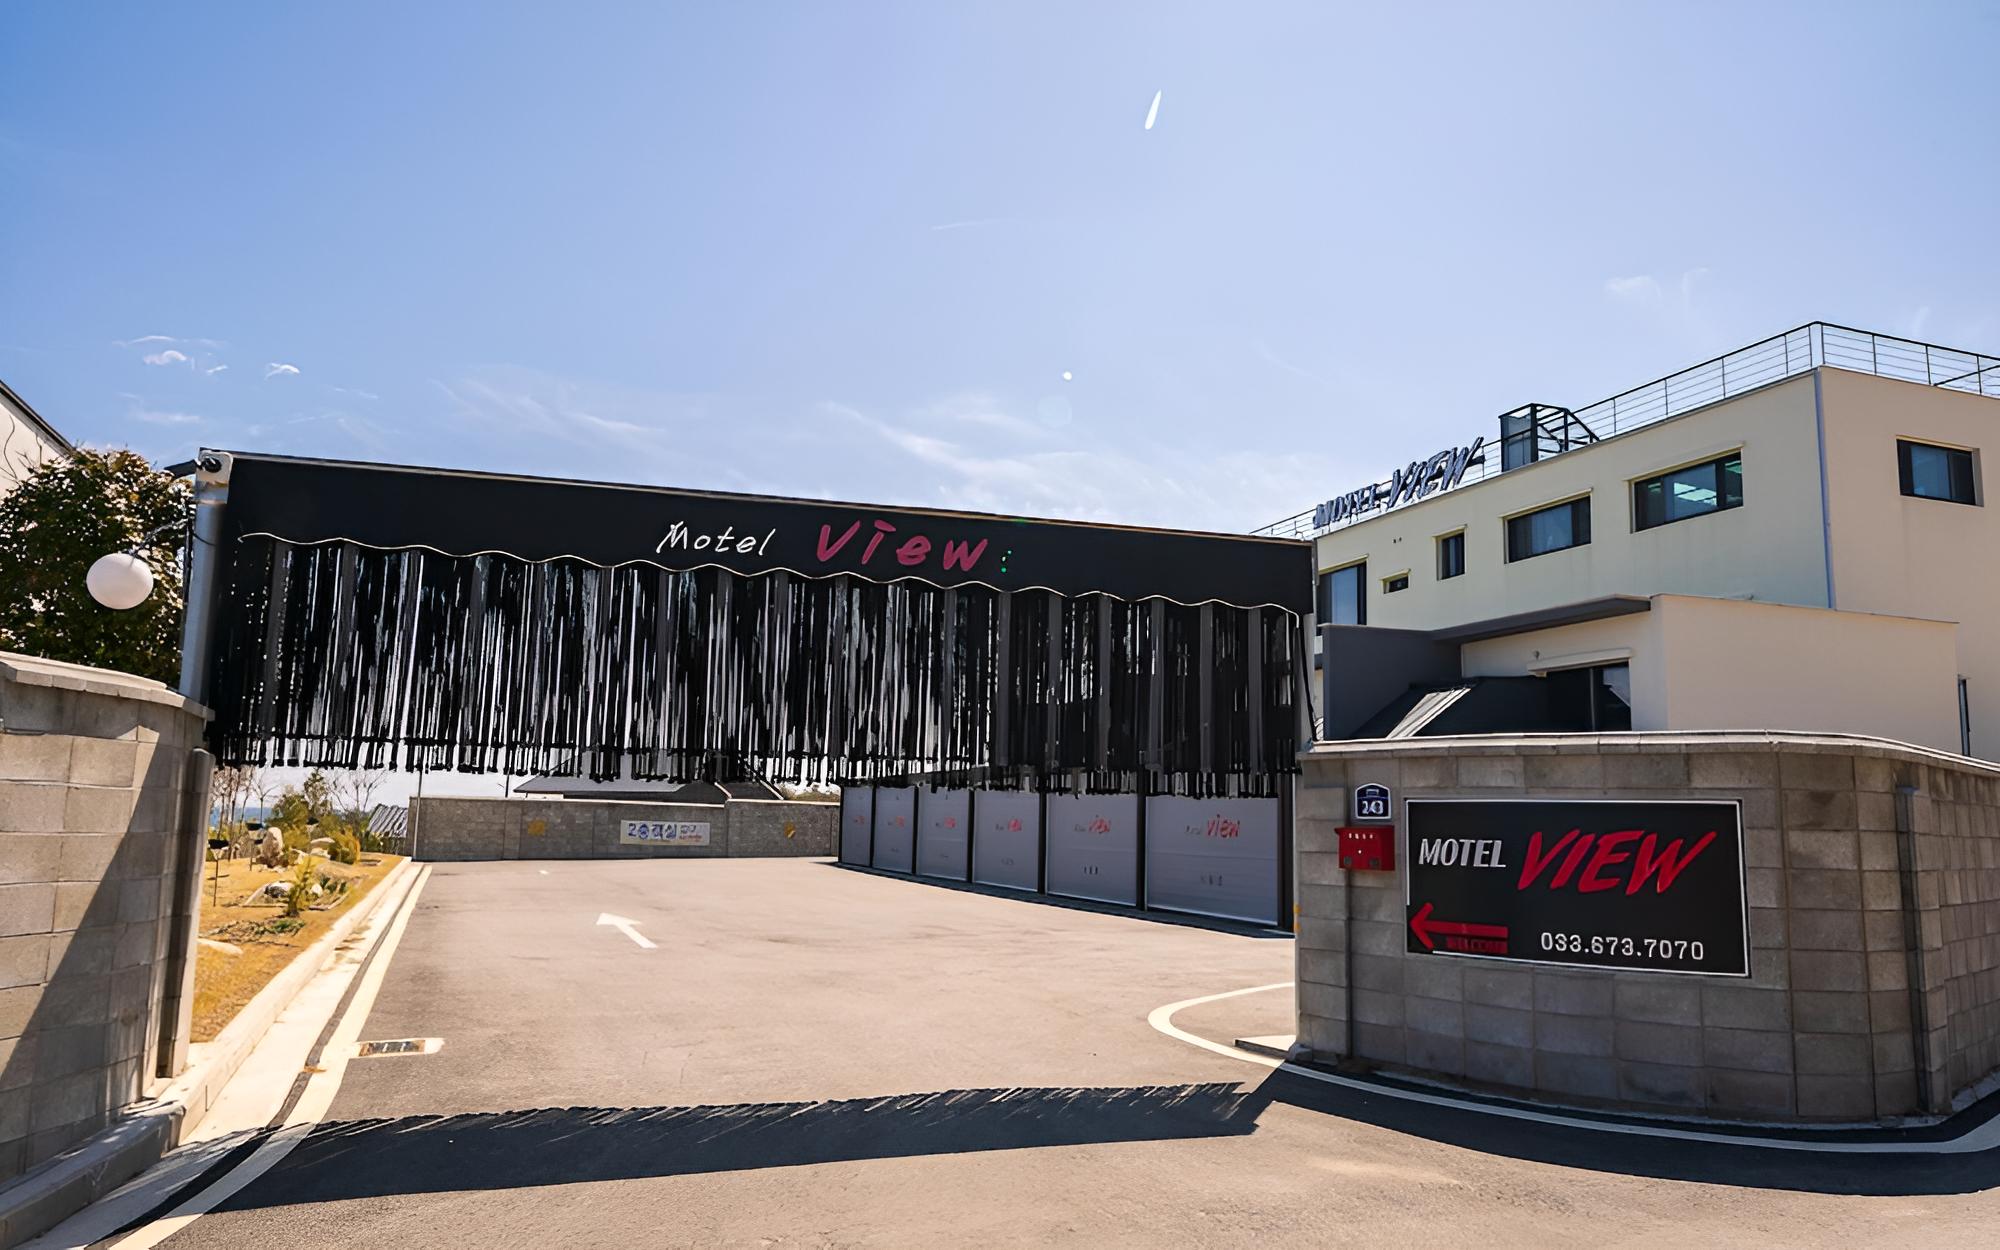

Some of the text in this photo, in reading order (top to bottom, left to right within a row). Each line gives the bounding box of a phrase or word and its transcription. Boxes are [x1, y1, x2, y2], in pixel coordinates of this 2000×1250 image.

[1387, 437, 1484, 508] VIEW
[656, 520, 988, 571] Motel View
[1418, 829, 1718, 895] MOTEL VIEW
[1540, 932, 1704, 961] 033.673.7070
